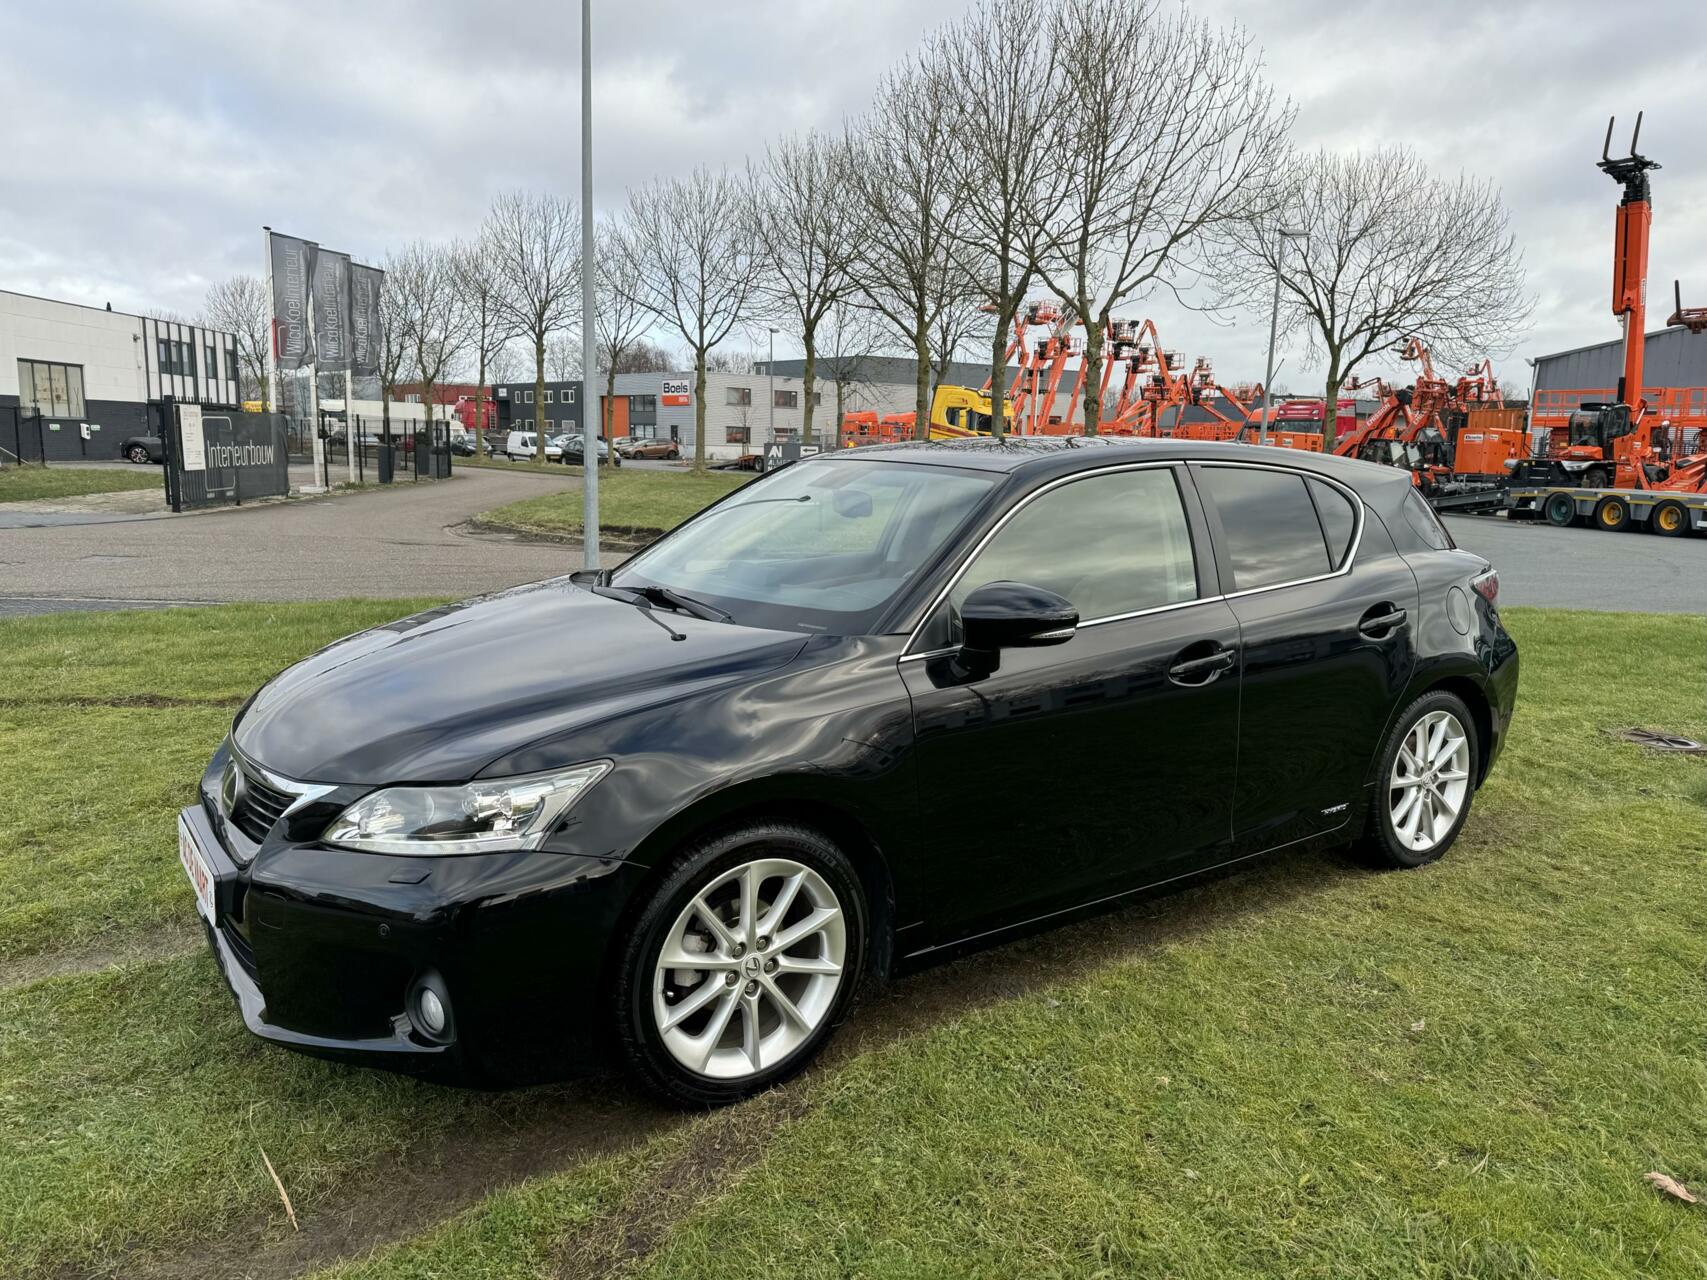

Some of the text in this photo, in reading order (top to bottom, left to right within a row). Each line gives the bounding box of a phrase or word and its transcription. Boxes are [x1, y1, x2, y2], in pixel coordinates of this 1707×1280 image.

[663, 382, 688, 393] Boels
[207, 440, 274, 468] Interieurbouw
[768, 445, 782, 458] AN
